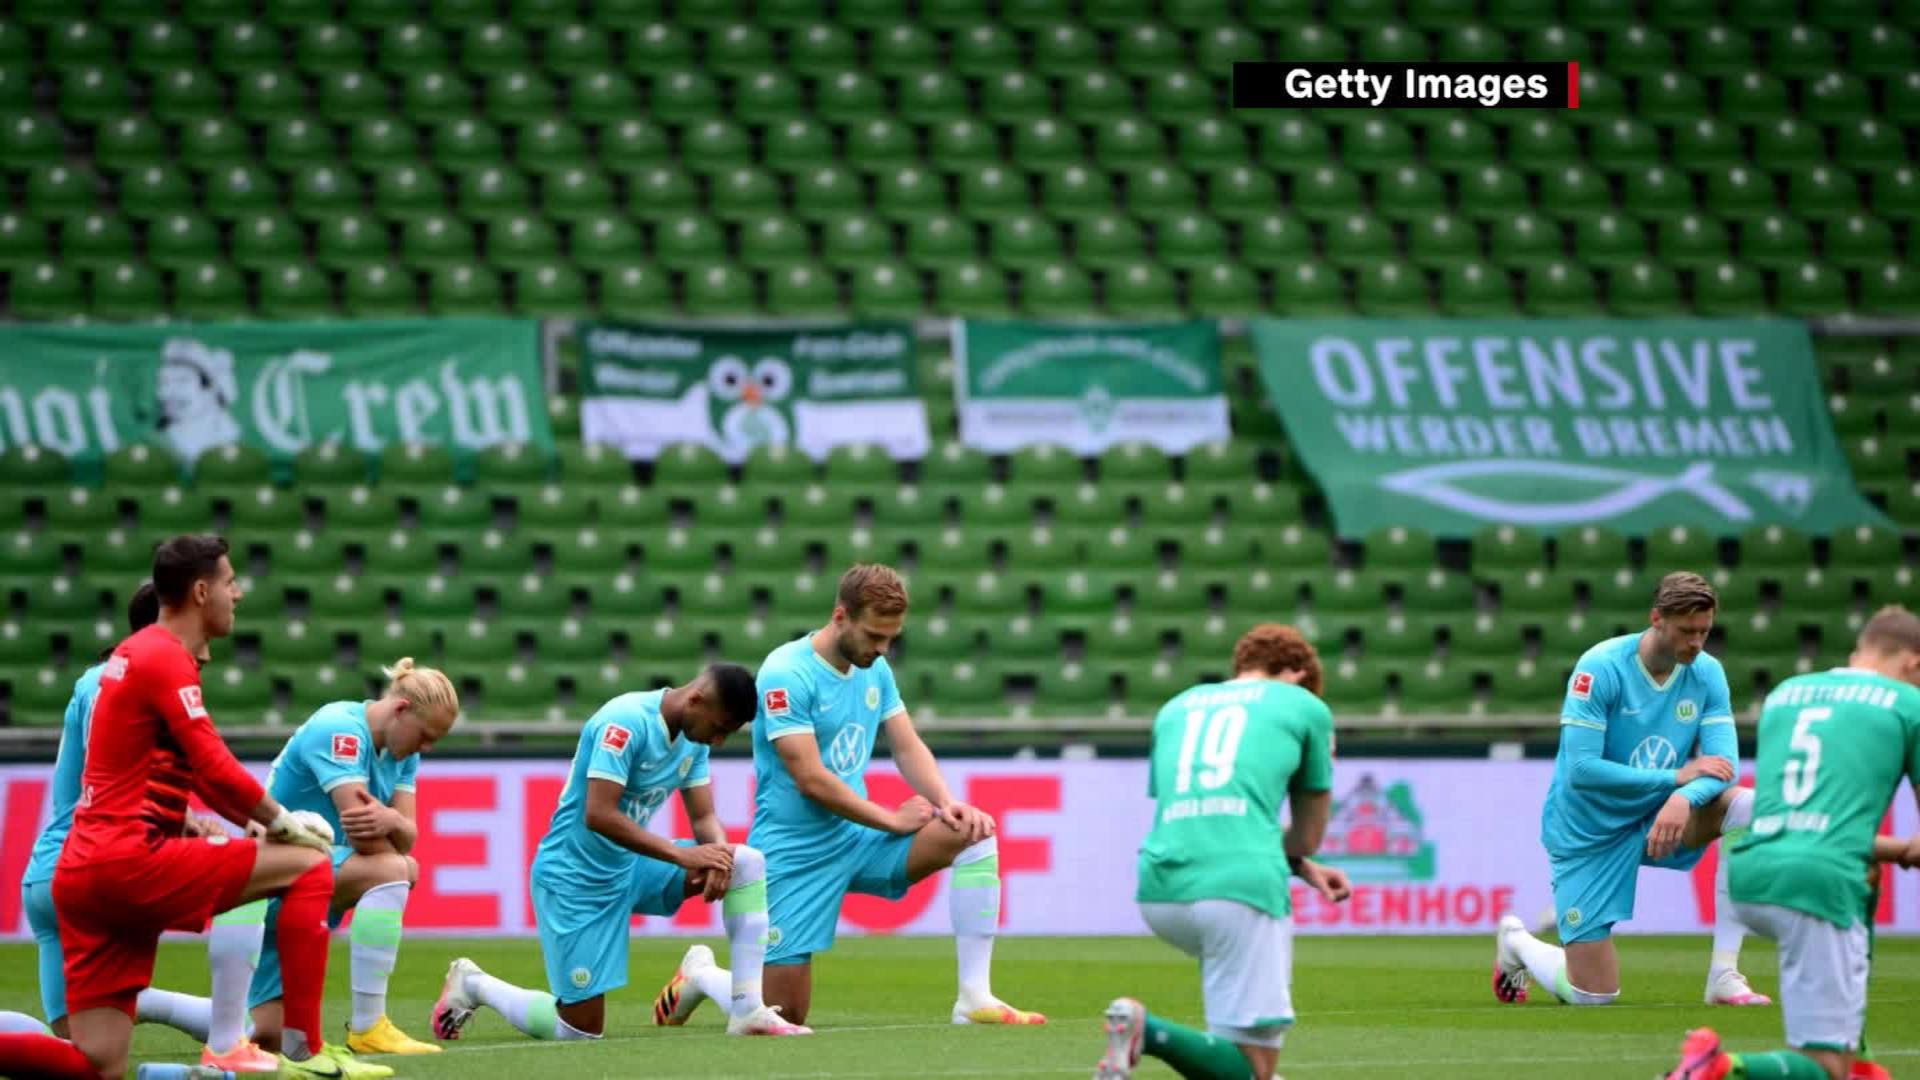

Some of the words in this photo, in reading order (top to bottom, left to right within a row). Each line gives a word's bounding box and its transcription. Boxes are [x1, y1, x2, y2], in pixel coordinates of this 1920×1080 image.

[253, 349, 532, 453] Crew
[1309, 336, 1772, 410] OFFENSIVE
[1334, 411, 1561, 456] WERDER
[1573, 413, 1794, 457] BREMEN
[1175, 703, 1249, 795] 19
[1782, 706, 1833, 808] 5
